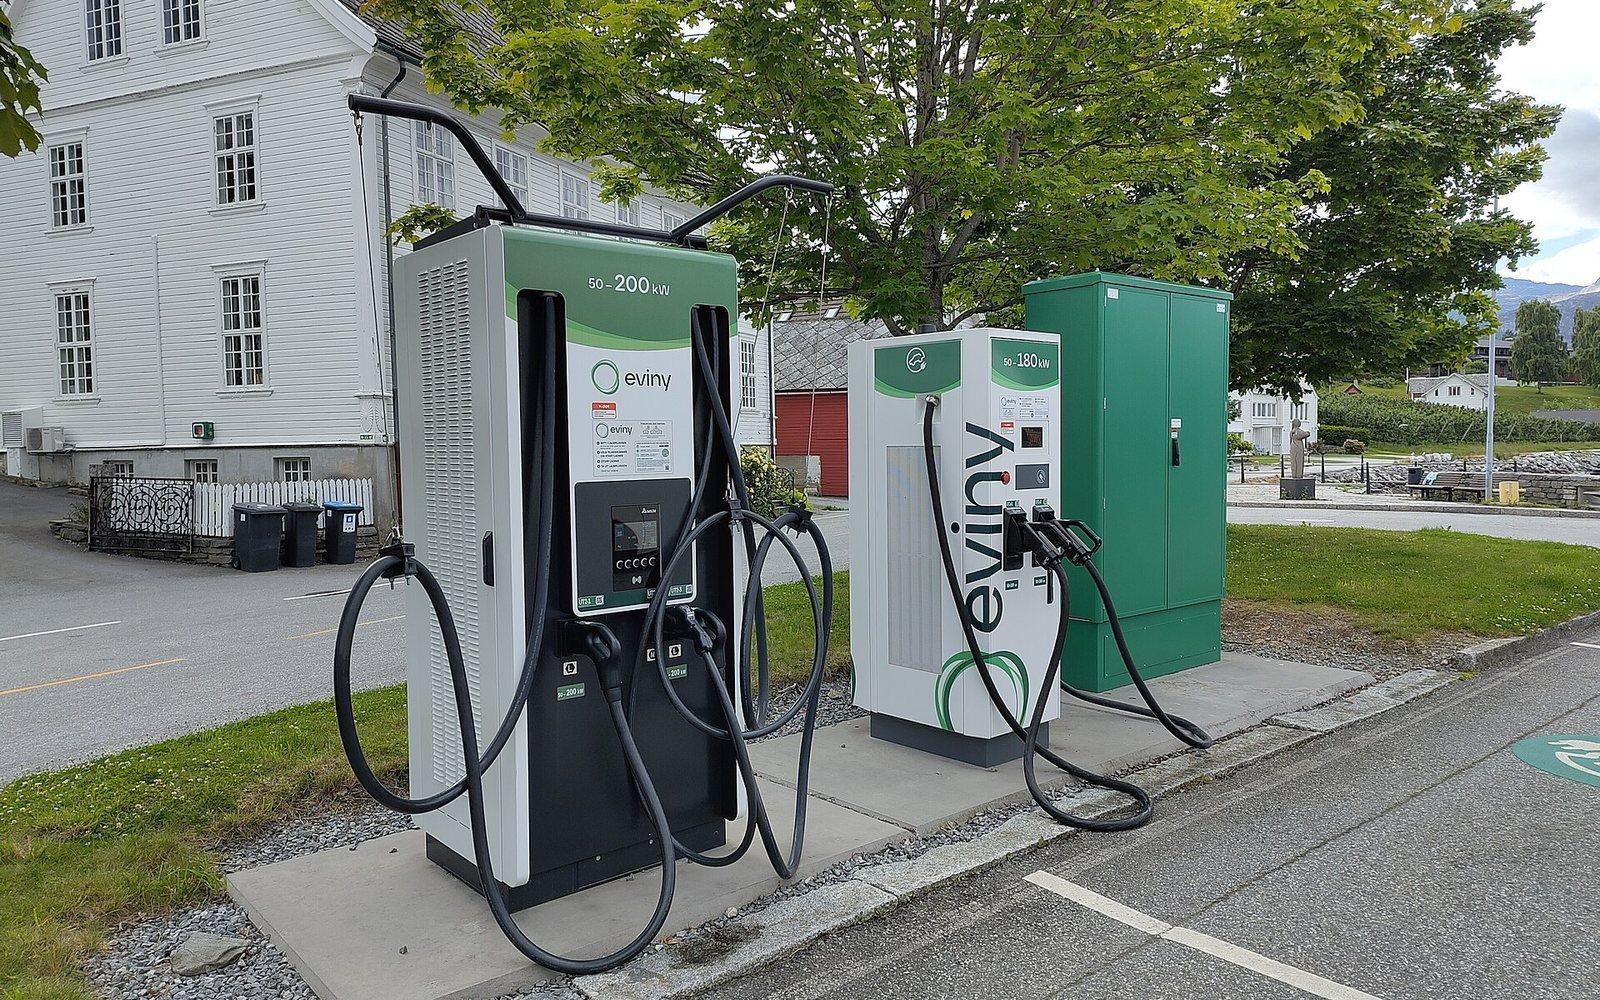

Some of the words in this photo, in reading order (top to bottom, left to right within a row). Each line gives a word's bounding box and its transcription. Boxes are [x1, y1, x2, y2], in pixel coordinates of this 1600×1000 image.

[651, 283, 670, 296] kW
[1038, 358, 1050, 369] kW
[624, 368, 671, 391] eviny
[609, 424, 633, 436] eviny
[950, 421, 1015, 634] eviny
